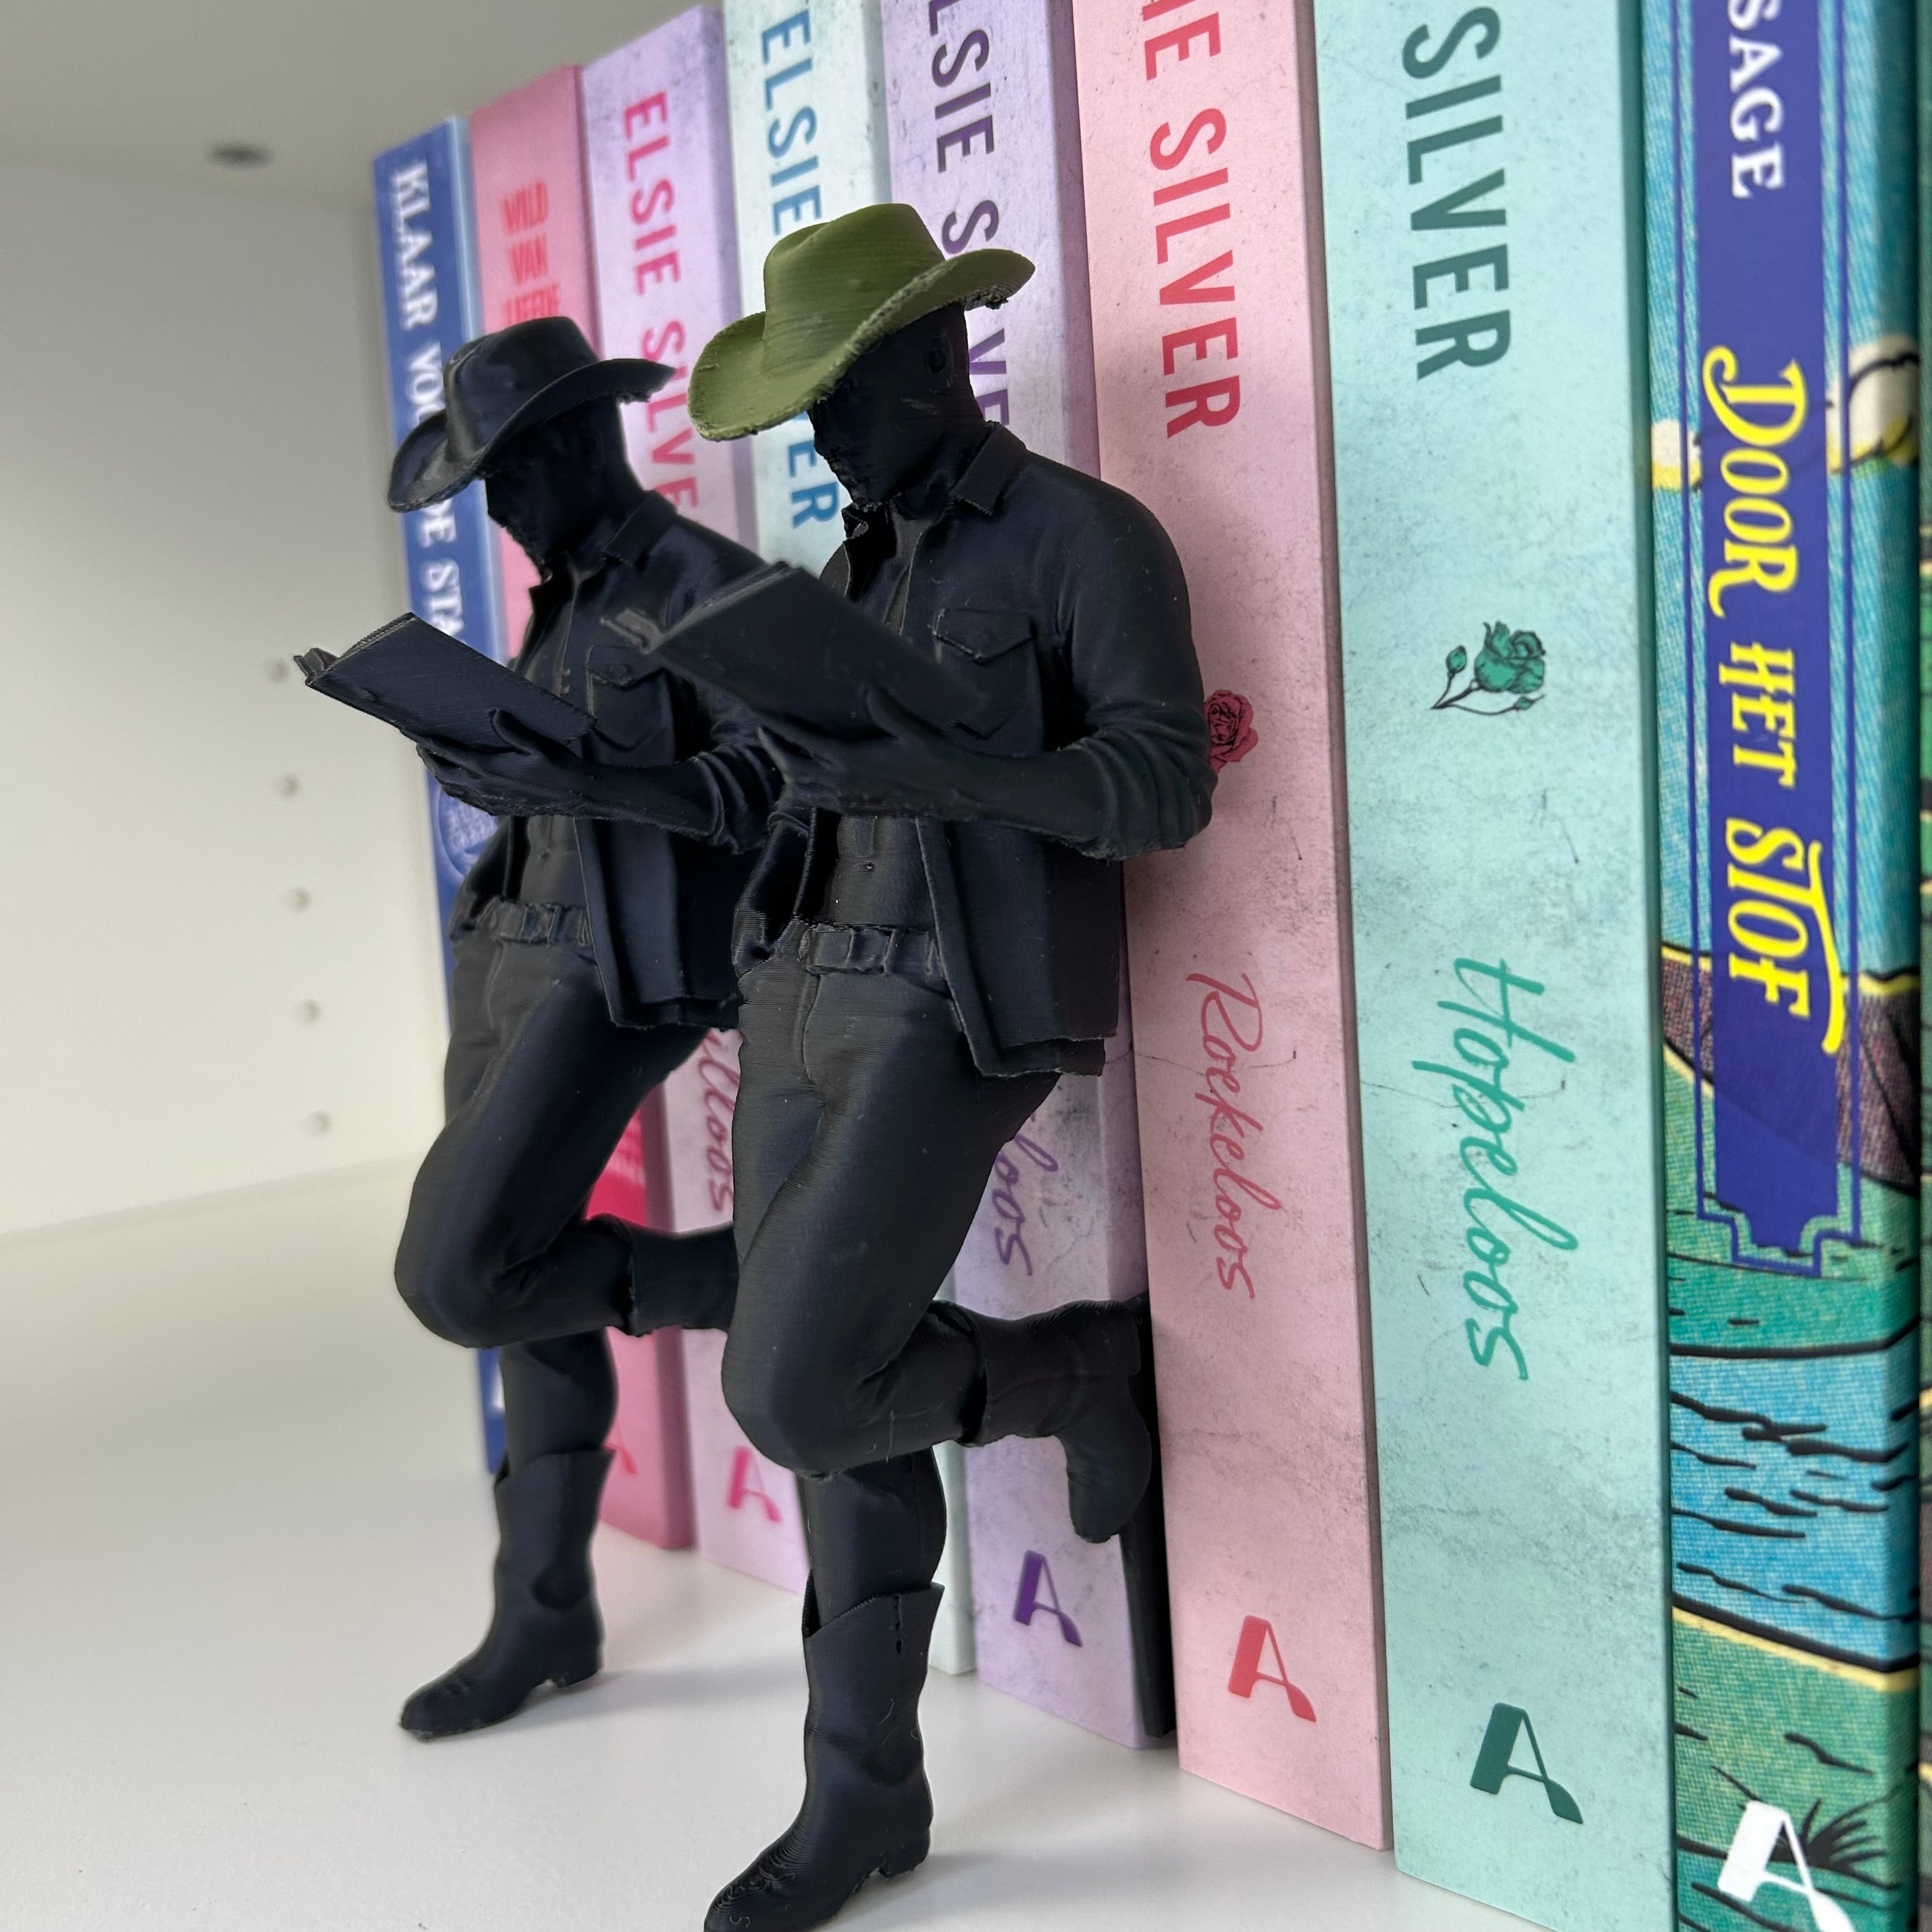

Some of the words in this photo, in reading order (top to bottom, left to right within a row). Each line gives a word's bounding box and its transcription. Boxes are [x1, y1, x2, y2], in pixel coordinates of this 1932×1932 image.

[622, 91, 681, 296] ELSIE
[760, 9, 823, 236] ELSIE
[929, 0, 995, 173] LSIE
[1401, 6, 1511, 381] SILVER
[1727, 0, 1784, 199] SAGE
[1149, 107, 1241, 438] SILVER
[641, 320, 699, 509] SLVE
[1702, 345, 1807, 617] DOOR
[1718, 641, 1796, 789] HET
[1724, 818, 1846, 1054] STOF
[1186, 972, 1282, 1300] Roekeloos
[1411, 957, 1579, 1382] Hopeloos
